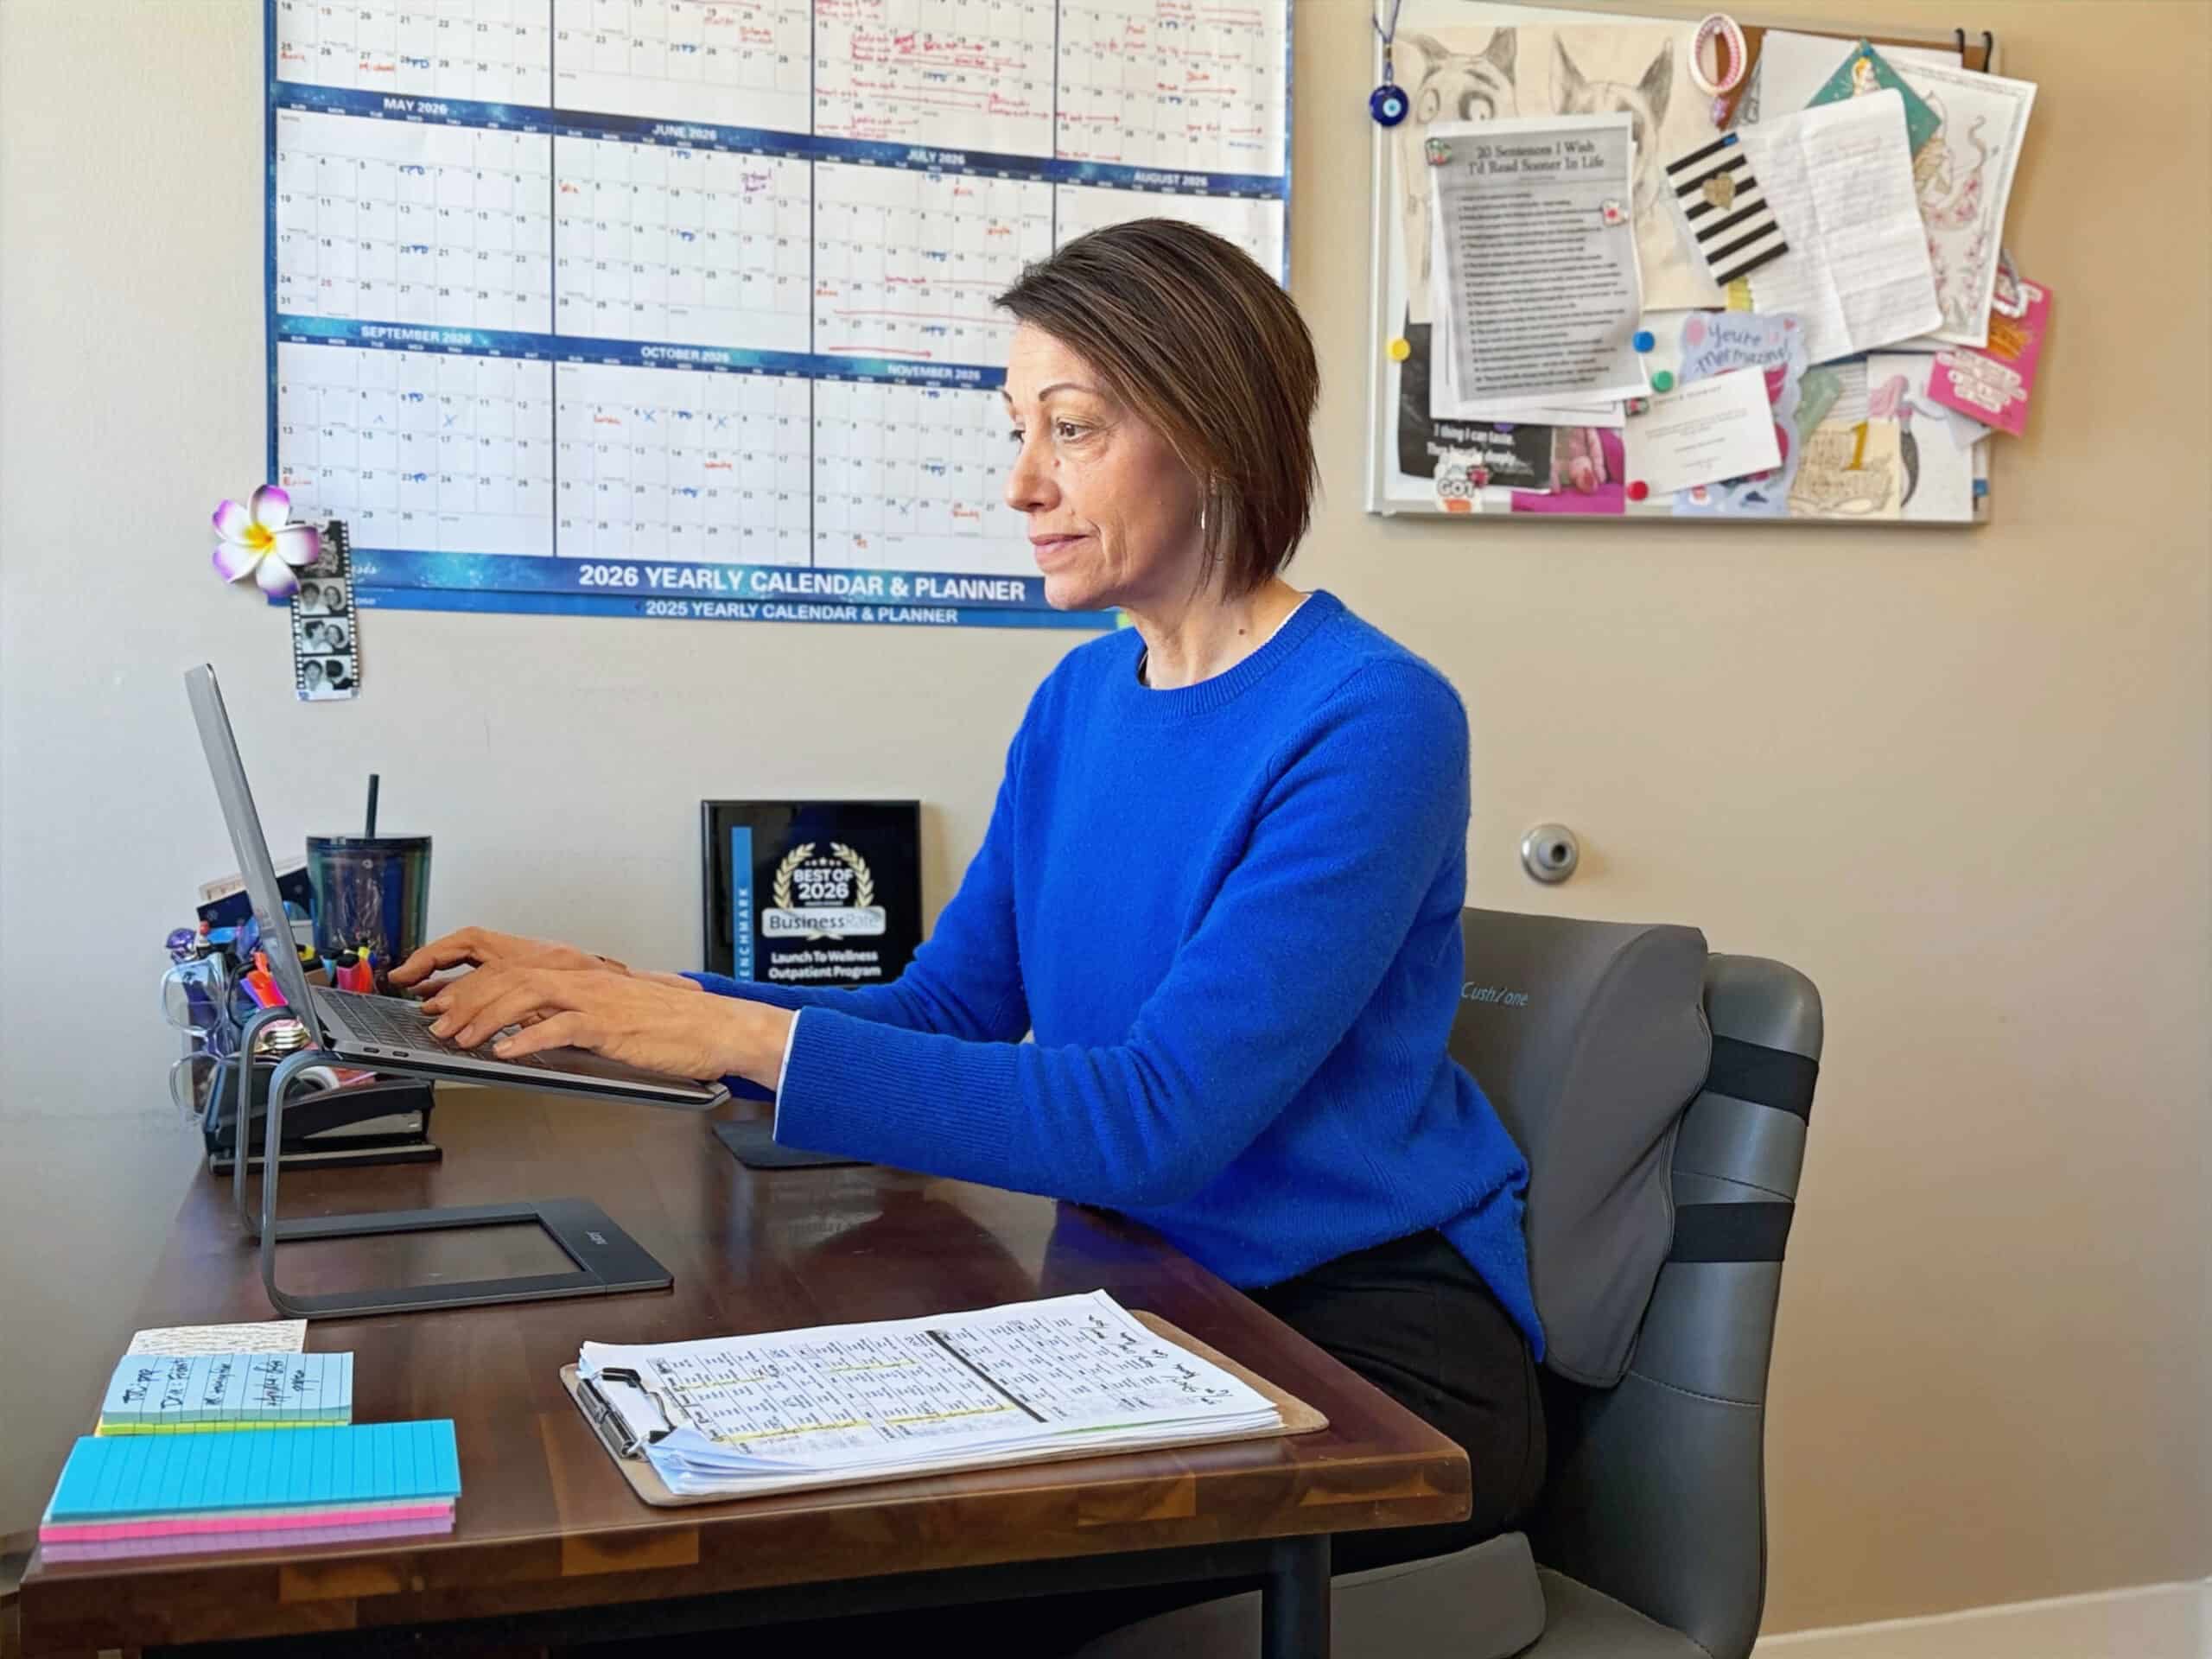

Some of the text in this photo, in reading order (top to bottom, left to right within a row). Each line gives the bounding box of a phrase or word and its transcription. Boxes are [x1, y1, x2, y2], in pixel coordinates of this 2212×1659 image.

[383, 99, 448, 115] MAY 2026
[652, 124, 687, 137] JUNE
[907, 150, 938, 162] JULY
[1477, 145, 1492, 159] 20
[1564, 139, 1595, 154] Wish
[1488, 159, 1518, 173] Read
[1521, 159, 1561, 171] Sooner
[1582, 155, 1605, 168] Life
[1133, 172, 1179, 185] AUGUST
[361, 326, 472, 345] SEPTEMBER 2026
[640, 346, 700, 360] OCTOBER
[887, 364, 953, 378] NOVEMBER
[579, 565, 1026, 601] 2026 YEARLY CALENDAR & PLANNER
[645, 601, 959, 623] 2025 YEARLY CALENDAR & PLANNER
[793, 868, 855, 882] BEST OF
[798, 882, 850, 899] 2026
[737, 888, 751, 982] ENCHMARK
[771, 950, 879, 964] Launch To Wellness
[768, 966, 882, 982] Outpatient Program
